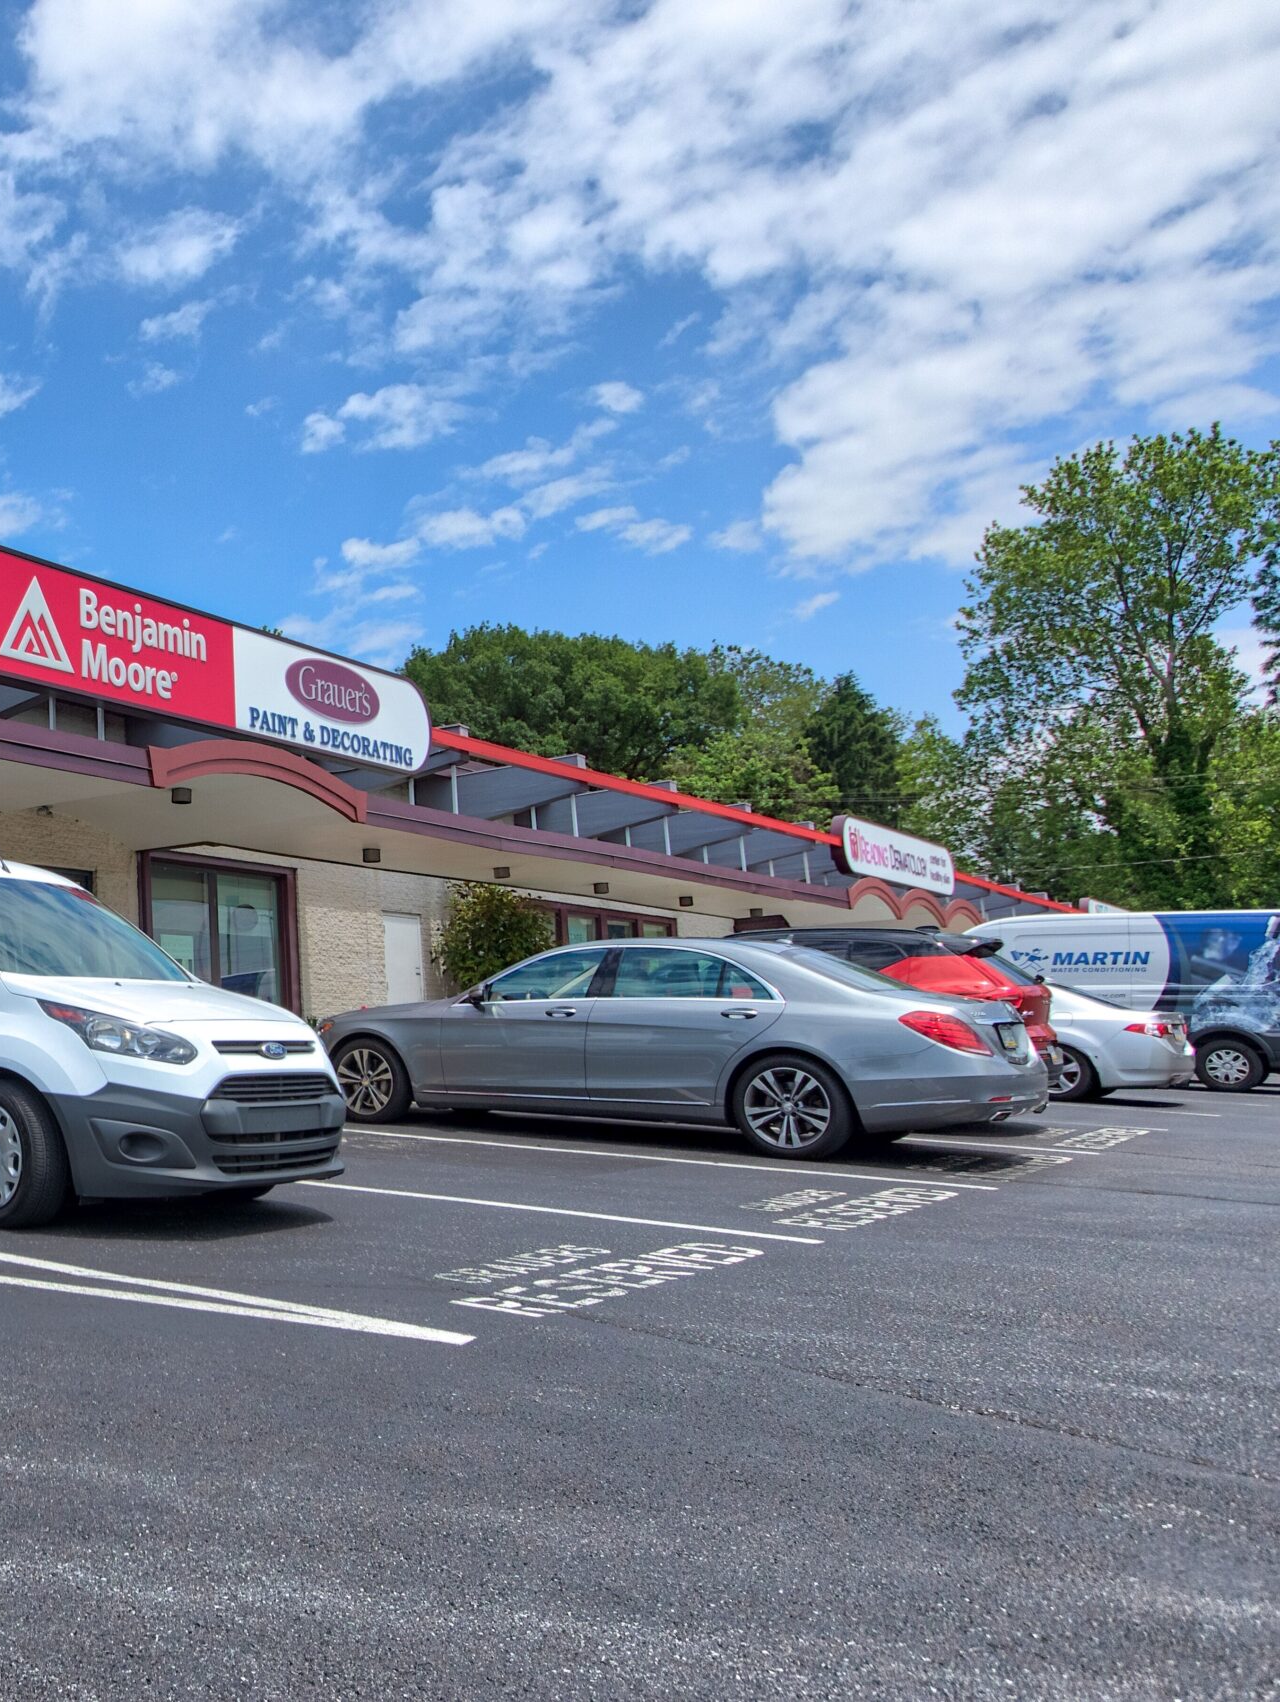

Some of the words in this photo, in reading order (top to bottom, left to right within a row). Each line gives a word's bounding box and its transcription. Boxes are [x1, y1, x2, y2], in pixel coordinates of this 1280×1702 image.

[79, 587, 207, 663] Benjamin
[298, 665, 371, 717] Grauer's
[248, 706, 299, 739] PAINT
[303, 721, 316, 743] &
[319, 725, 414, 768] DECORATING
[1052, 951, 1150, 966] MARTIN
[772, 1187, 959, 1231] RESERVED
[449, 1242, 765, 1318] RESERVED
